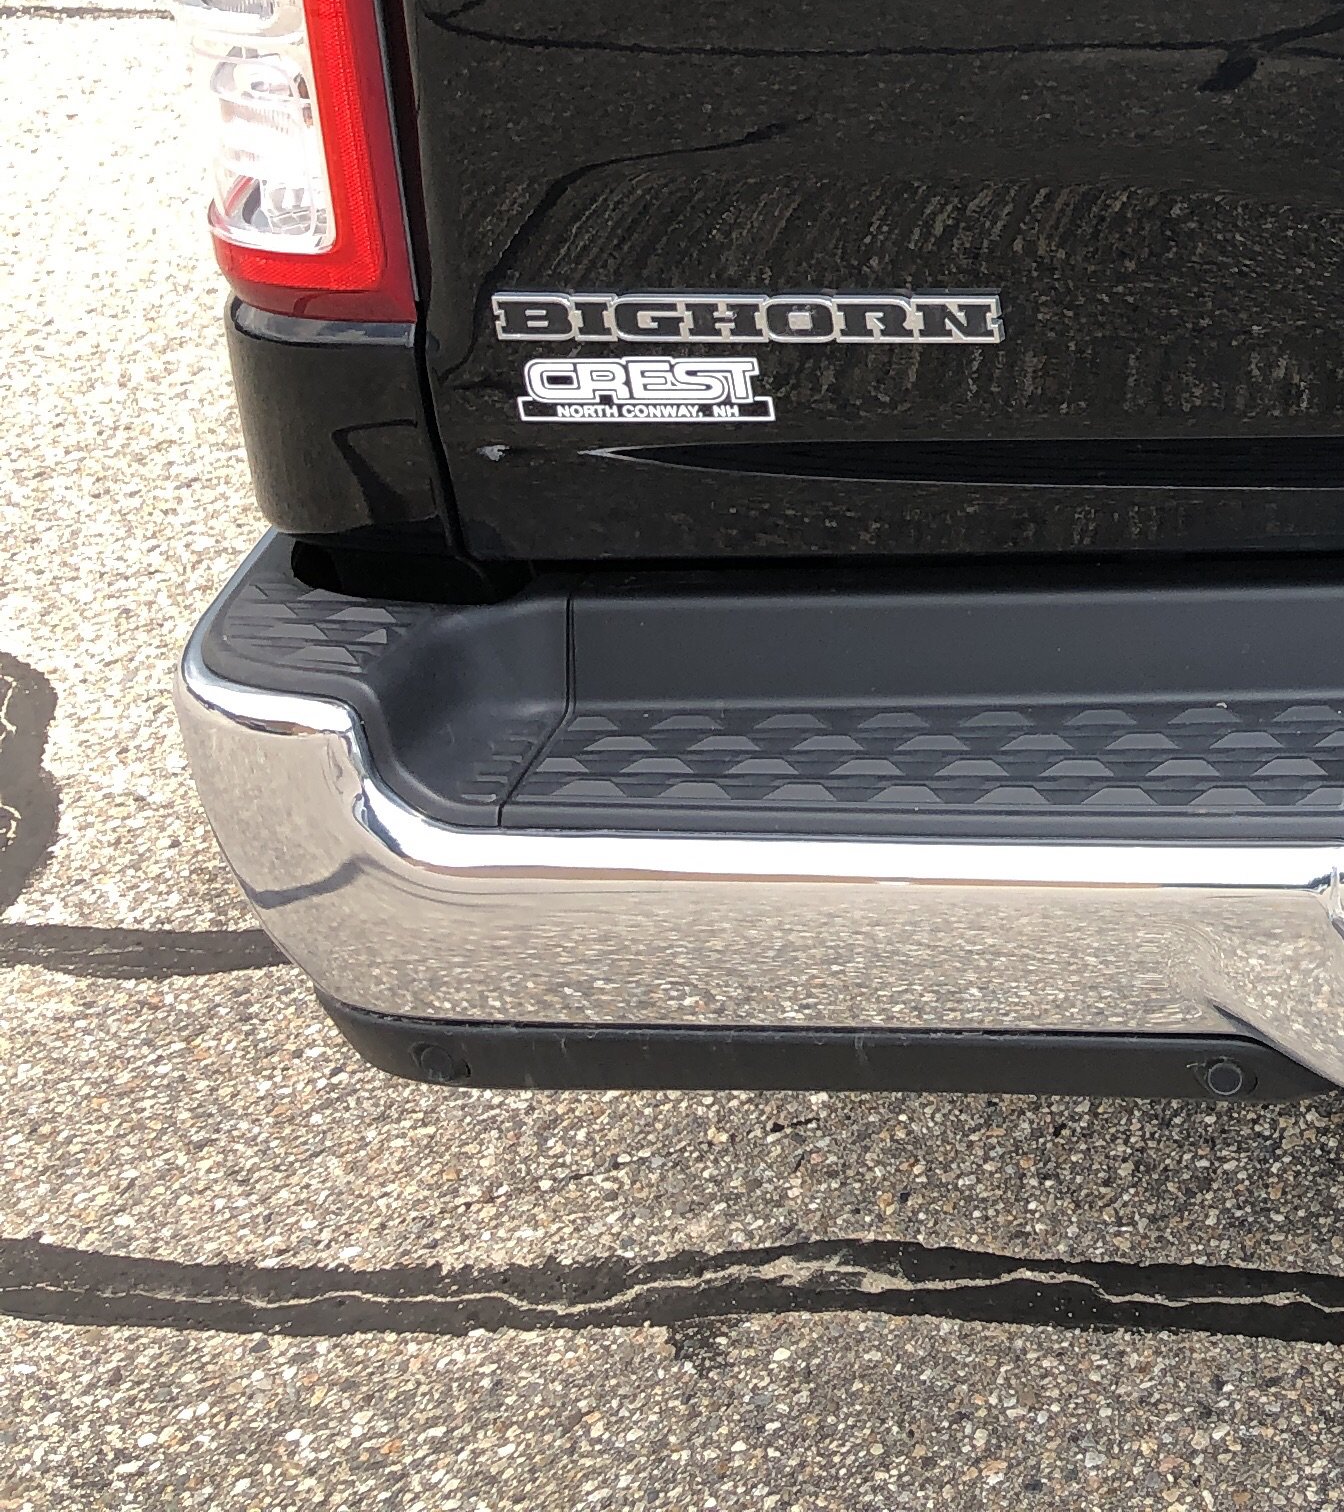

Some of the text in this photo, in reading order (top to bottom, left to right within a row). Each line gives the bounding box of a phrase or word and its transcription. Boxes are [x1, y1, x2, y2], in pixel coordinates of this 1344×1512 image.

[491, 292, 1005, 344] BIGHORN
[525, 356, 760, 403] CREST
[556, 404, 740, 419] NORTH CONWAY, NH
